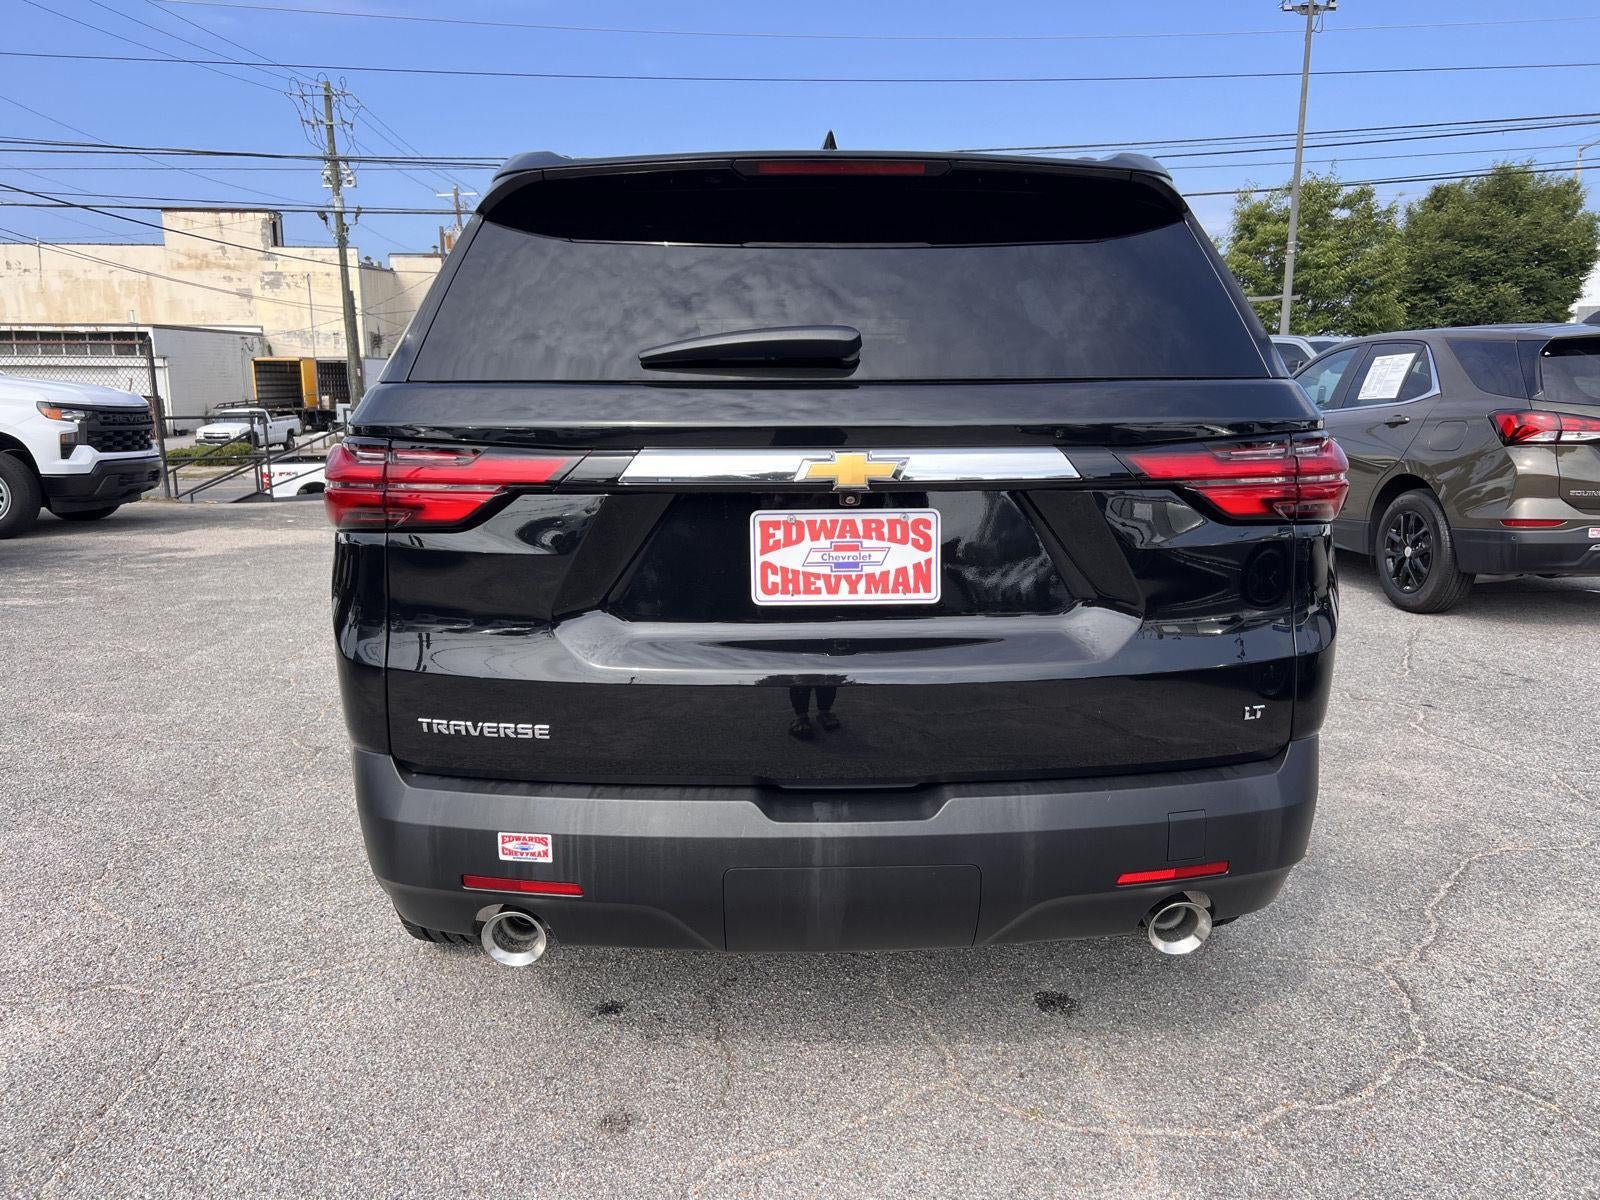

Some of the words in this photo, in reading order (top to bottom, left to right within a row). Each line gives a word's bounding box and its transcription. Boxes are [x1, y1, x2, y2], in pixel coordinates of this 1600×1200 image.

[759, 518, 933, 556] EDWARDS
[821, 552, 872, 562] Chevrolet
[760, 557, 933, 596] CHEVYMAN
[1244, 704, 1266, 721] LT
[417, 718, 550, 739] TRAVERSE
[501, 834, 549, 847] EDWARDS
[501, 846, 549, 858] CHEVYMAN
